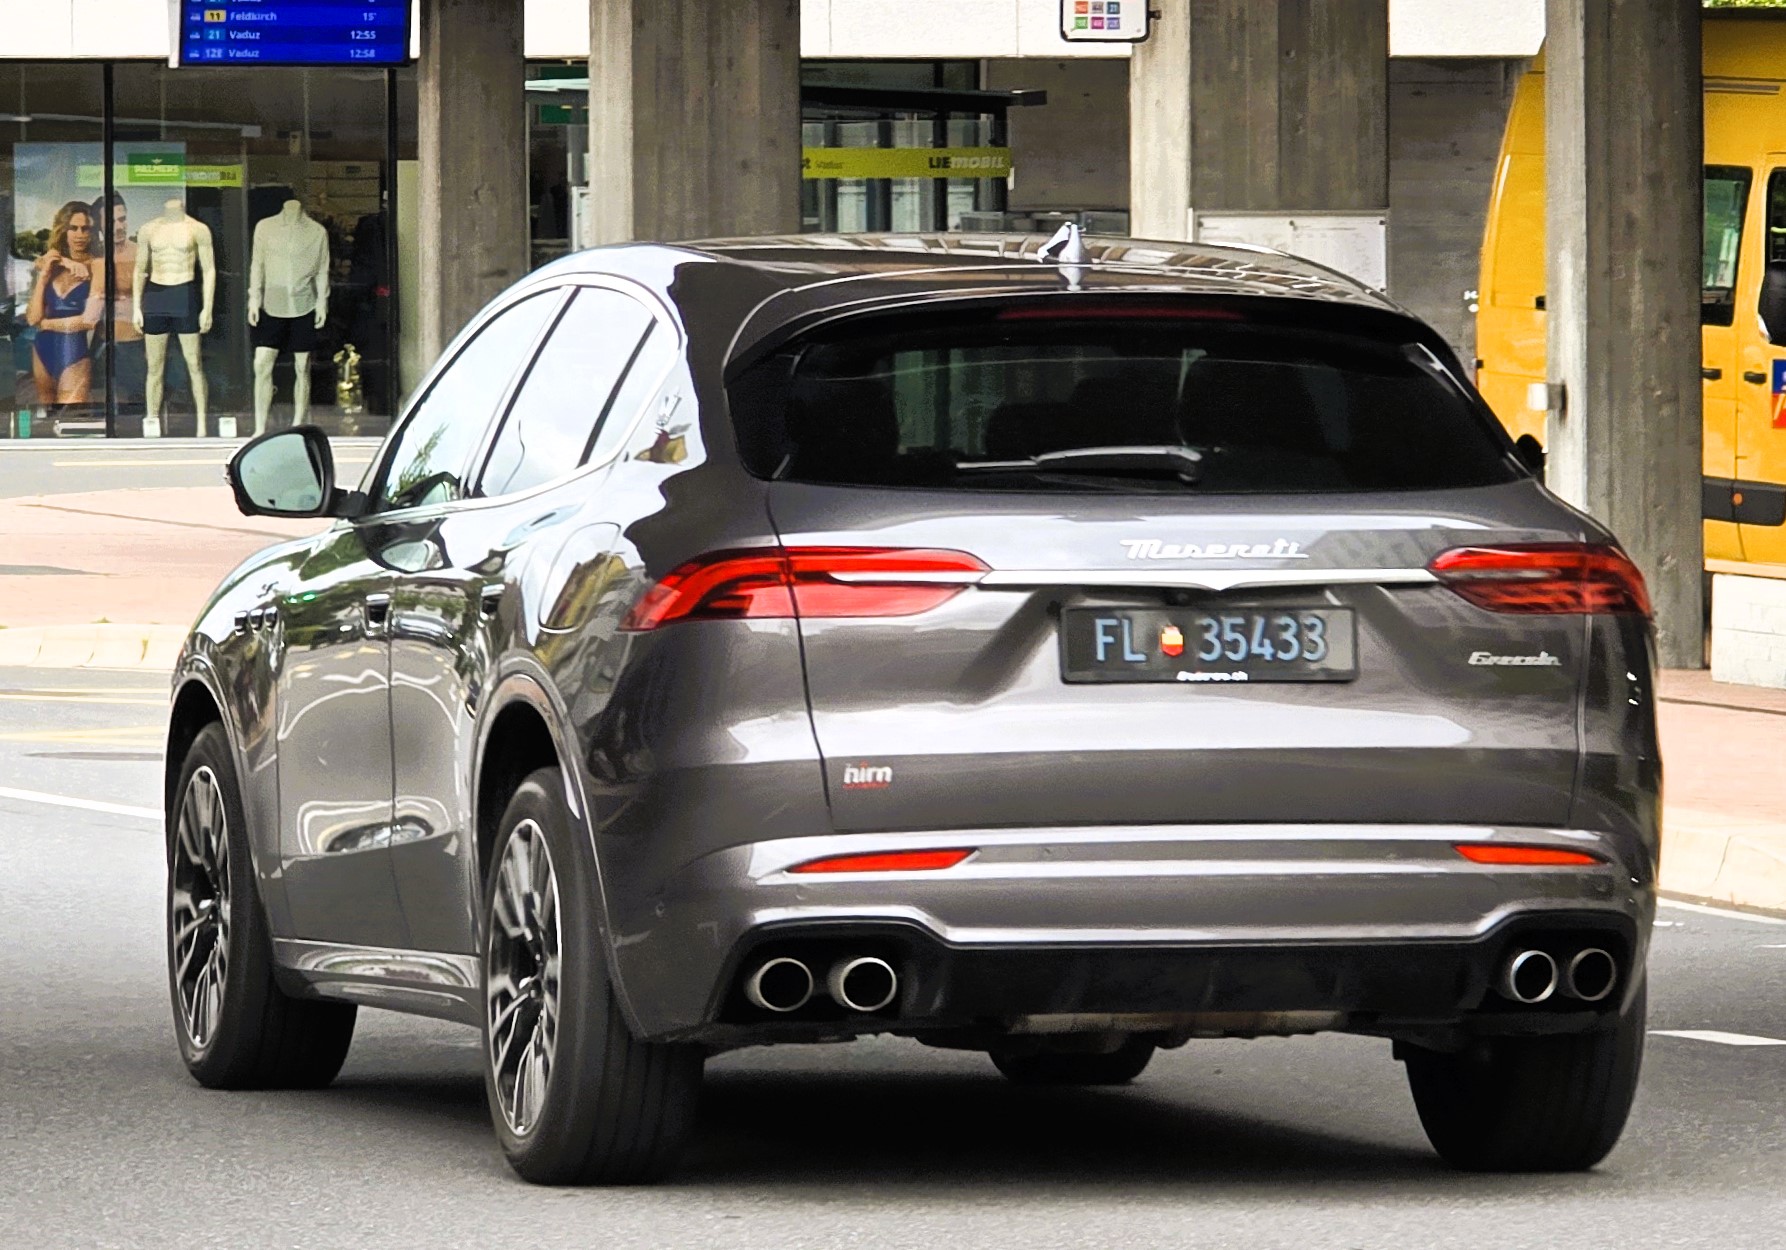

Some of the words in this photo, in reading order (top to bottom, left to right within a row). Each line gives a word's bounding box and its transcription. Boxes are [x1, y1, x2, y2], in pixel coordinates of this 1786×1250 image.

[209, 12, 221, 21] 11
[230, 11, 277, 21] Feldkirch
[208, 30, 220, 40] 21
[229, 30, 261, 40] Vaduz
[350, 30, 376, 40] 12:55
[229, 49, 260, 58] Vaduz
[928, 156, 1005, 169] LIEMOBIL
[1119, 538, 1310, 560] Maserati
[1095, 618, 1147, 662] FL
[1195, 616, 1328, 662] 35433
